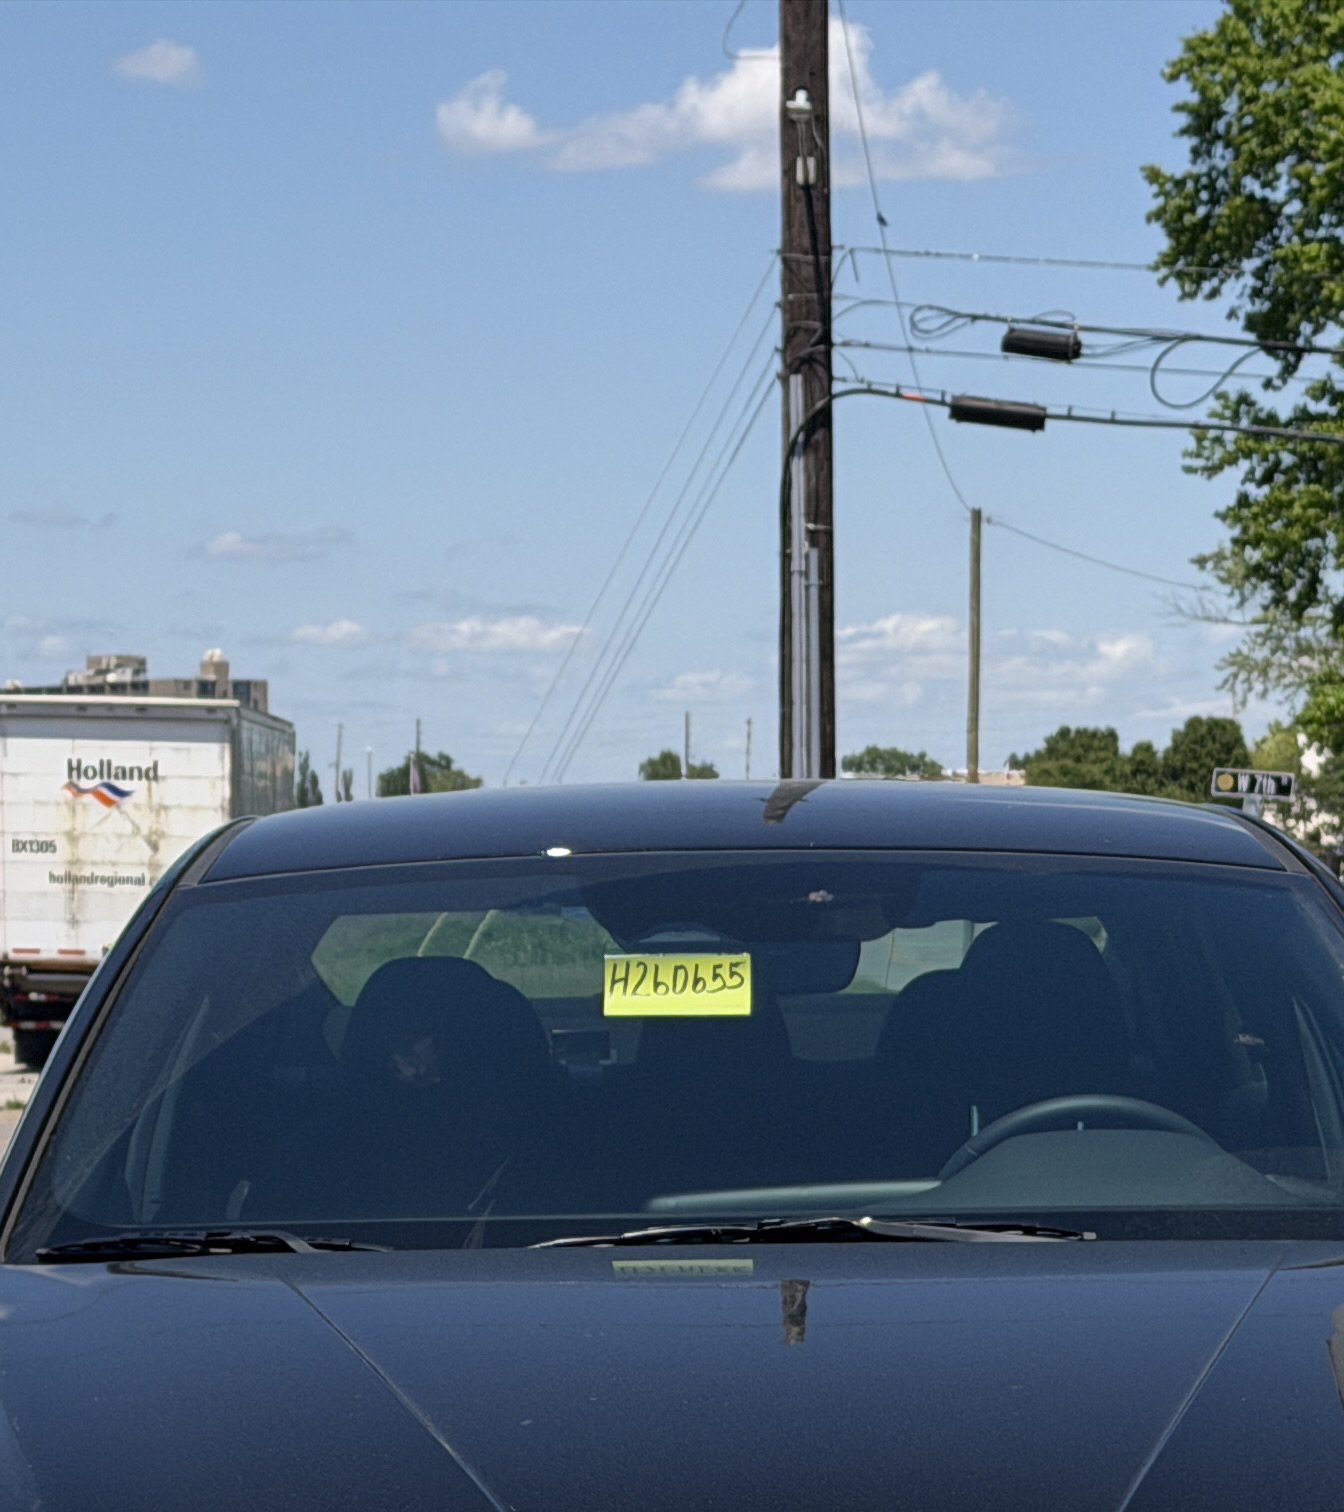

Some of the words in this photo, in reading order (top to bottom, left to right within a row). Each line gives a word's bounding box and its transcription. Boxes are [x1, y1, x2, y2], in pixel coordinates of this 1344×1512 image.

[67, 758, 158, 782] Holland
[1238, 773, 1249, 793] W
[609, 960, 747, 997] H260655
